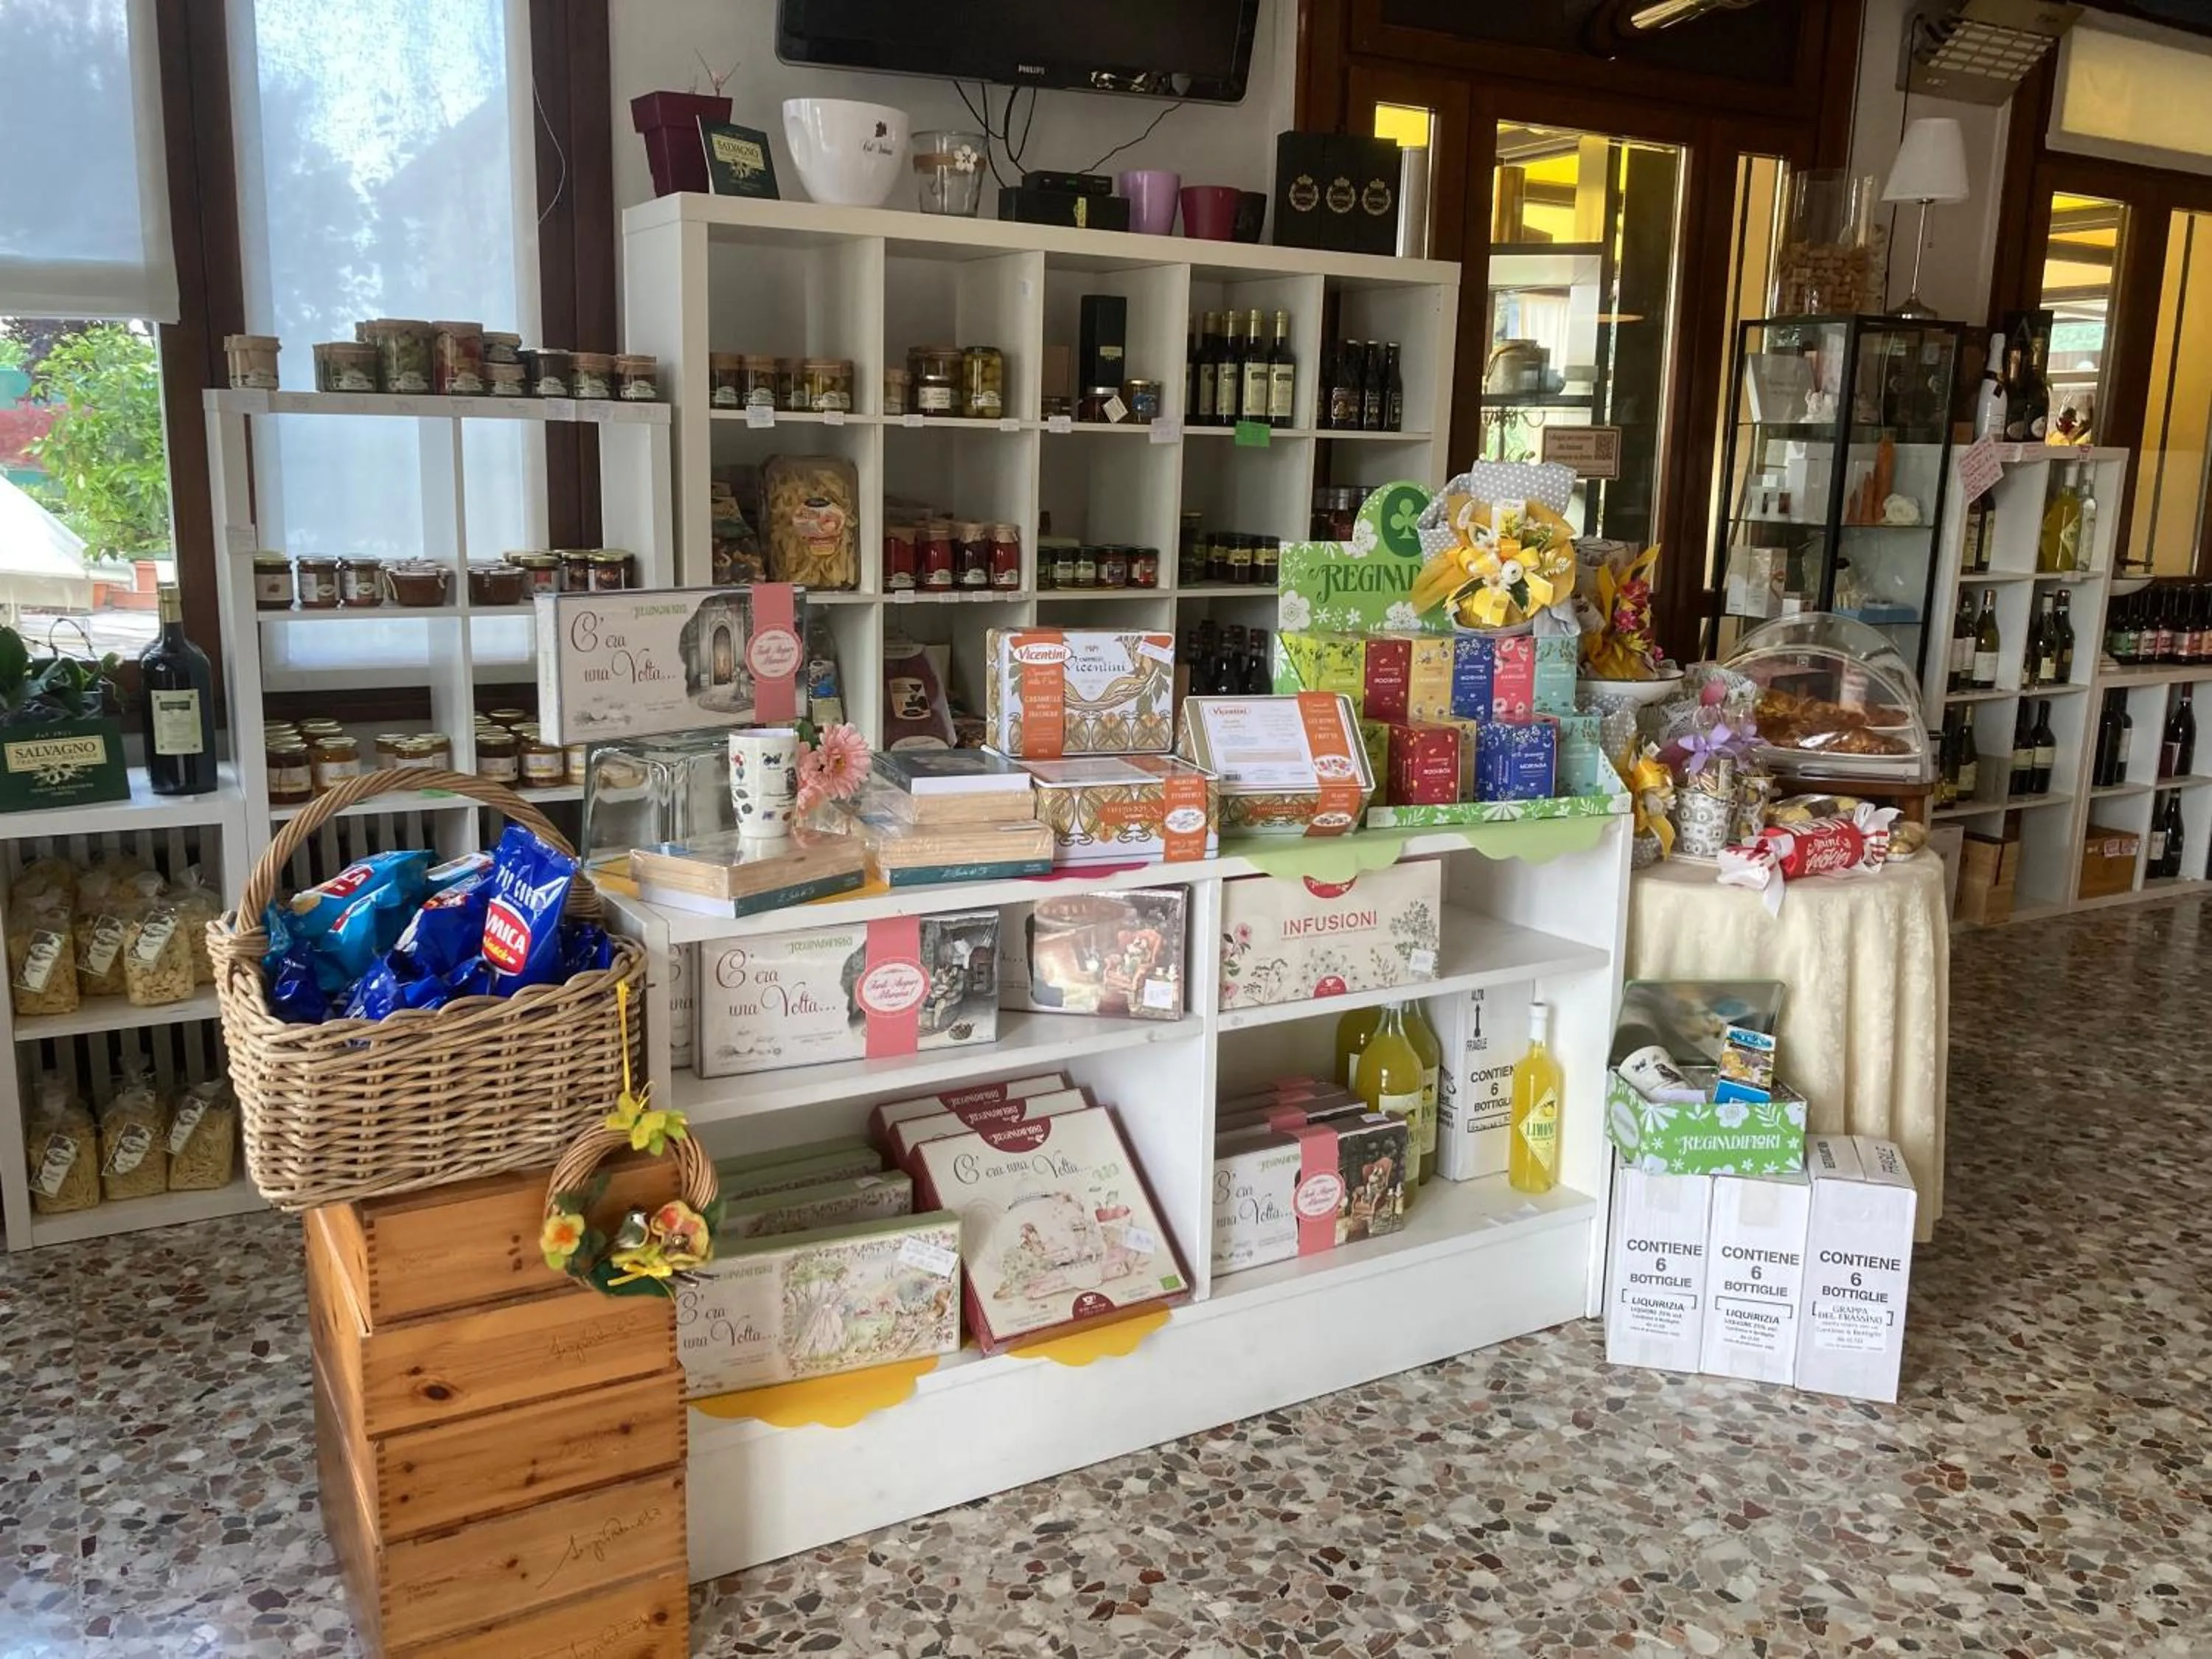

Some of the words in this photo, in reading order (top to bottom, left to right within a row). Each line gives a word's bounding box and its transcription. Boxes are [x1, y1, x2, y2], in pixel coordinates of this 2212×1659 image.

[716, 139, 759, 159] SALVAGNO
[1308, 563, 1422, 604] REGINAD
[1018, 648, 1067, 661] Vicentini
[15, 741, 97, 759] SALVAGNO
[484, 906, 526, 956] MICA
[1284, 910, 1377, 936] INFUSIONI
[1470, 1065, 1516, 1083] CONTIEN
[1490, 1082, 1499, 1095] 6
[1474, 1098, 1512, 1112] BOTTIGLI
[1627, 1238, 1703, 1256] CONTIENE
[1721, 1245, 1801, 1266] CONTIENE
[1819, 1250, 1902, 1272] CONTIENE
[1655, 1257, 1667, 1272] 6
[1750, 1265, 1762, 1280] 6
[1630, 1273, 1693, 1288] BOTTIGLIE
[1850, 1272, 1863, 1287] 6
[1724, 1281, 1788, 1298] BOTTIGLIE
[1822, 1285, 1889, 1303] BOTTIGLIE
[1631, 1297, 1684, 1311] LIQUIRIZIA
[1832, 1305, 1868, 1315] GRAPPA
[1726, 1309, 1780, 1325] LIQUIRIZIA
[1838, 1314, 1883, 1324] FRASSINO
